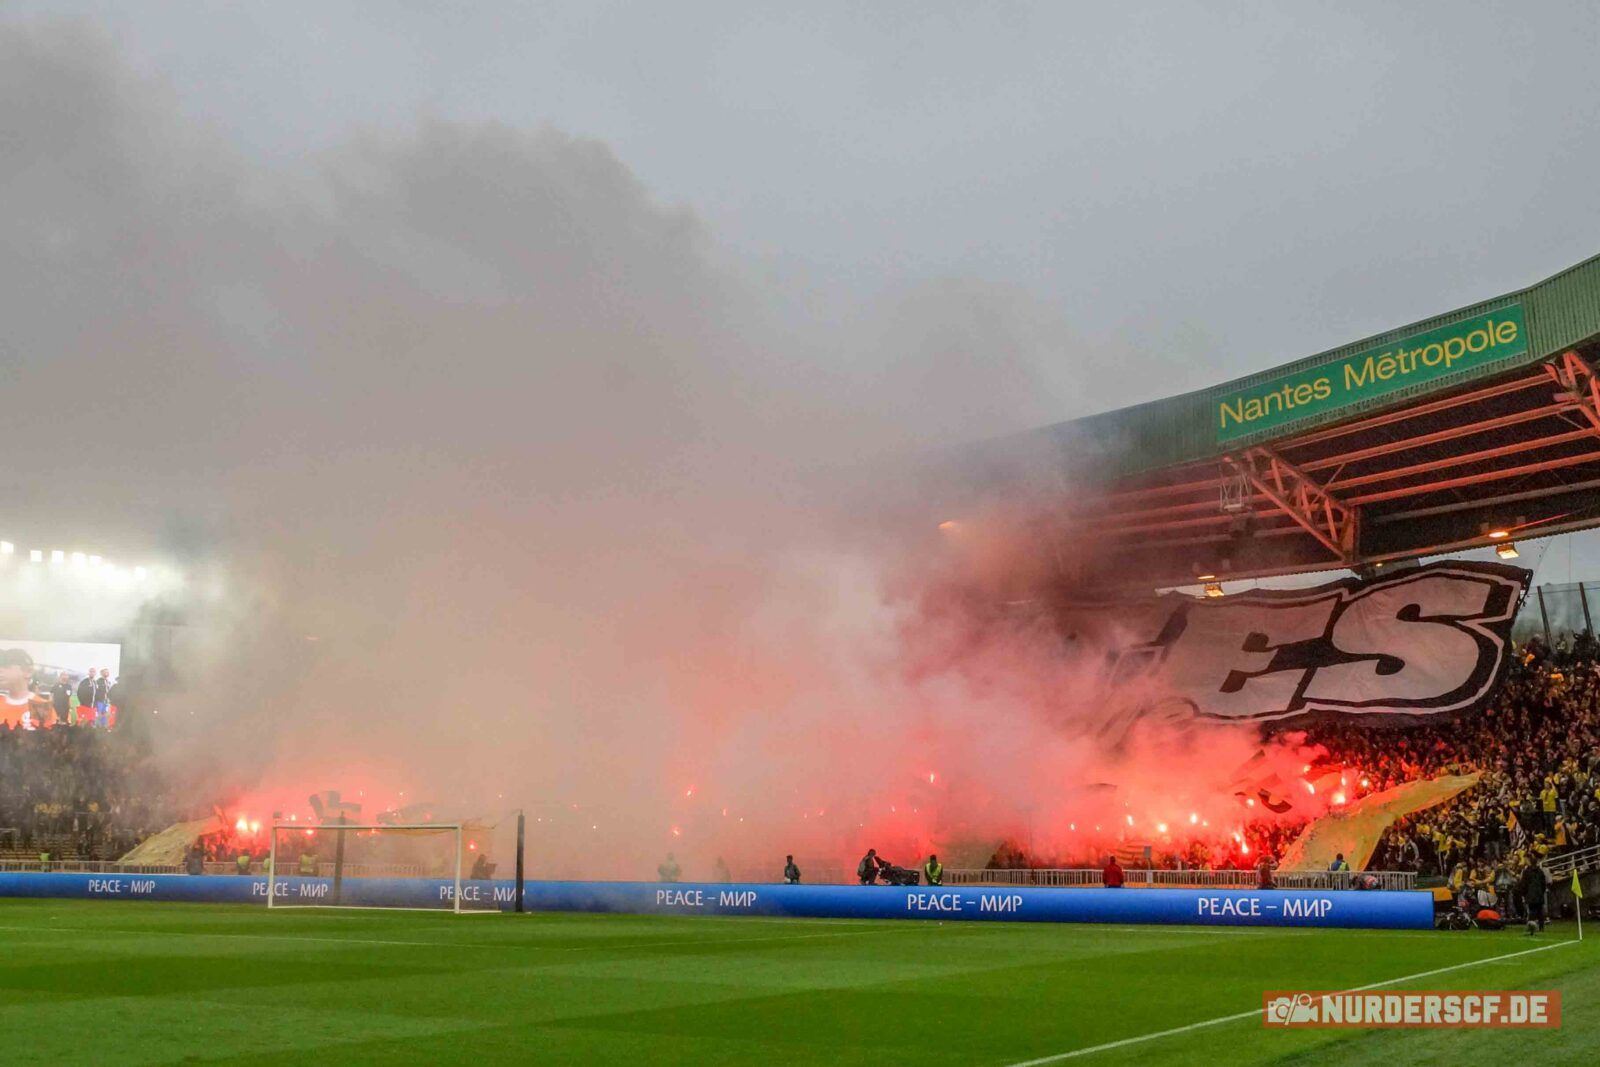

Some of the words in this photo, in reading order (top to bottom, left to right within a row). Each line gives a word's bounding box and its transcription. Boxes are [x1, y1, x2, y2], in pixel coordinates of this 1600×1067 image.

[1219, 377, 1332, 428] Nantes
[1343, 319, 1518, 391] Métropole
[1163, 576, 1493, 717] ES
[88, 879, 121, 893] PEACE
[130, 880, 156, 893] МИР
[300, 883, 329, 897] МИР
[656, 889, 704, 906] PEACE
[719, 890, 757, 907] МИР
[907, 893, 962, 911] PEACE
[980, 894, 1023, 912] МИР
[1198, 897, 1262, 916] PEACE
[1283, 898, 1333, 917] МИР
